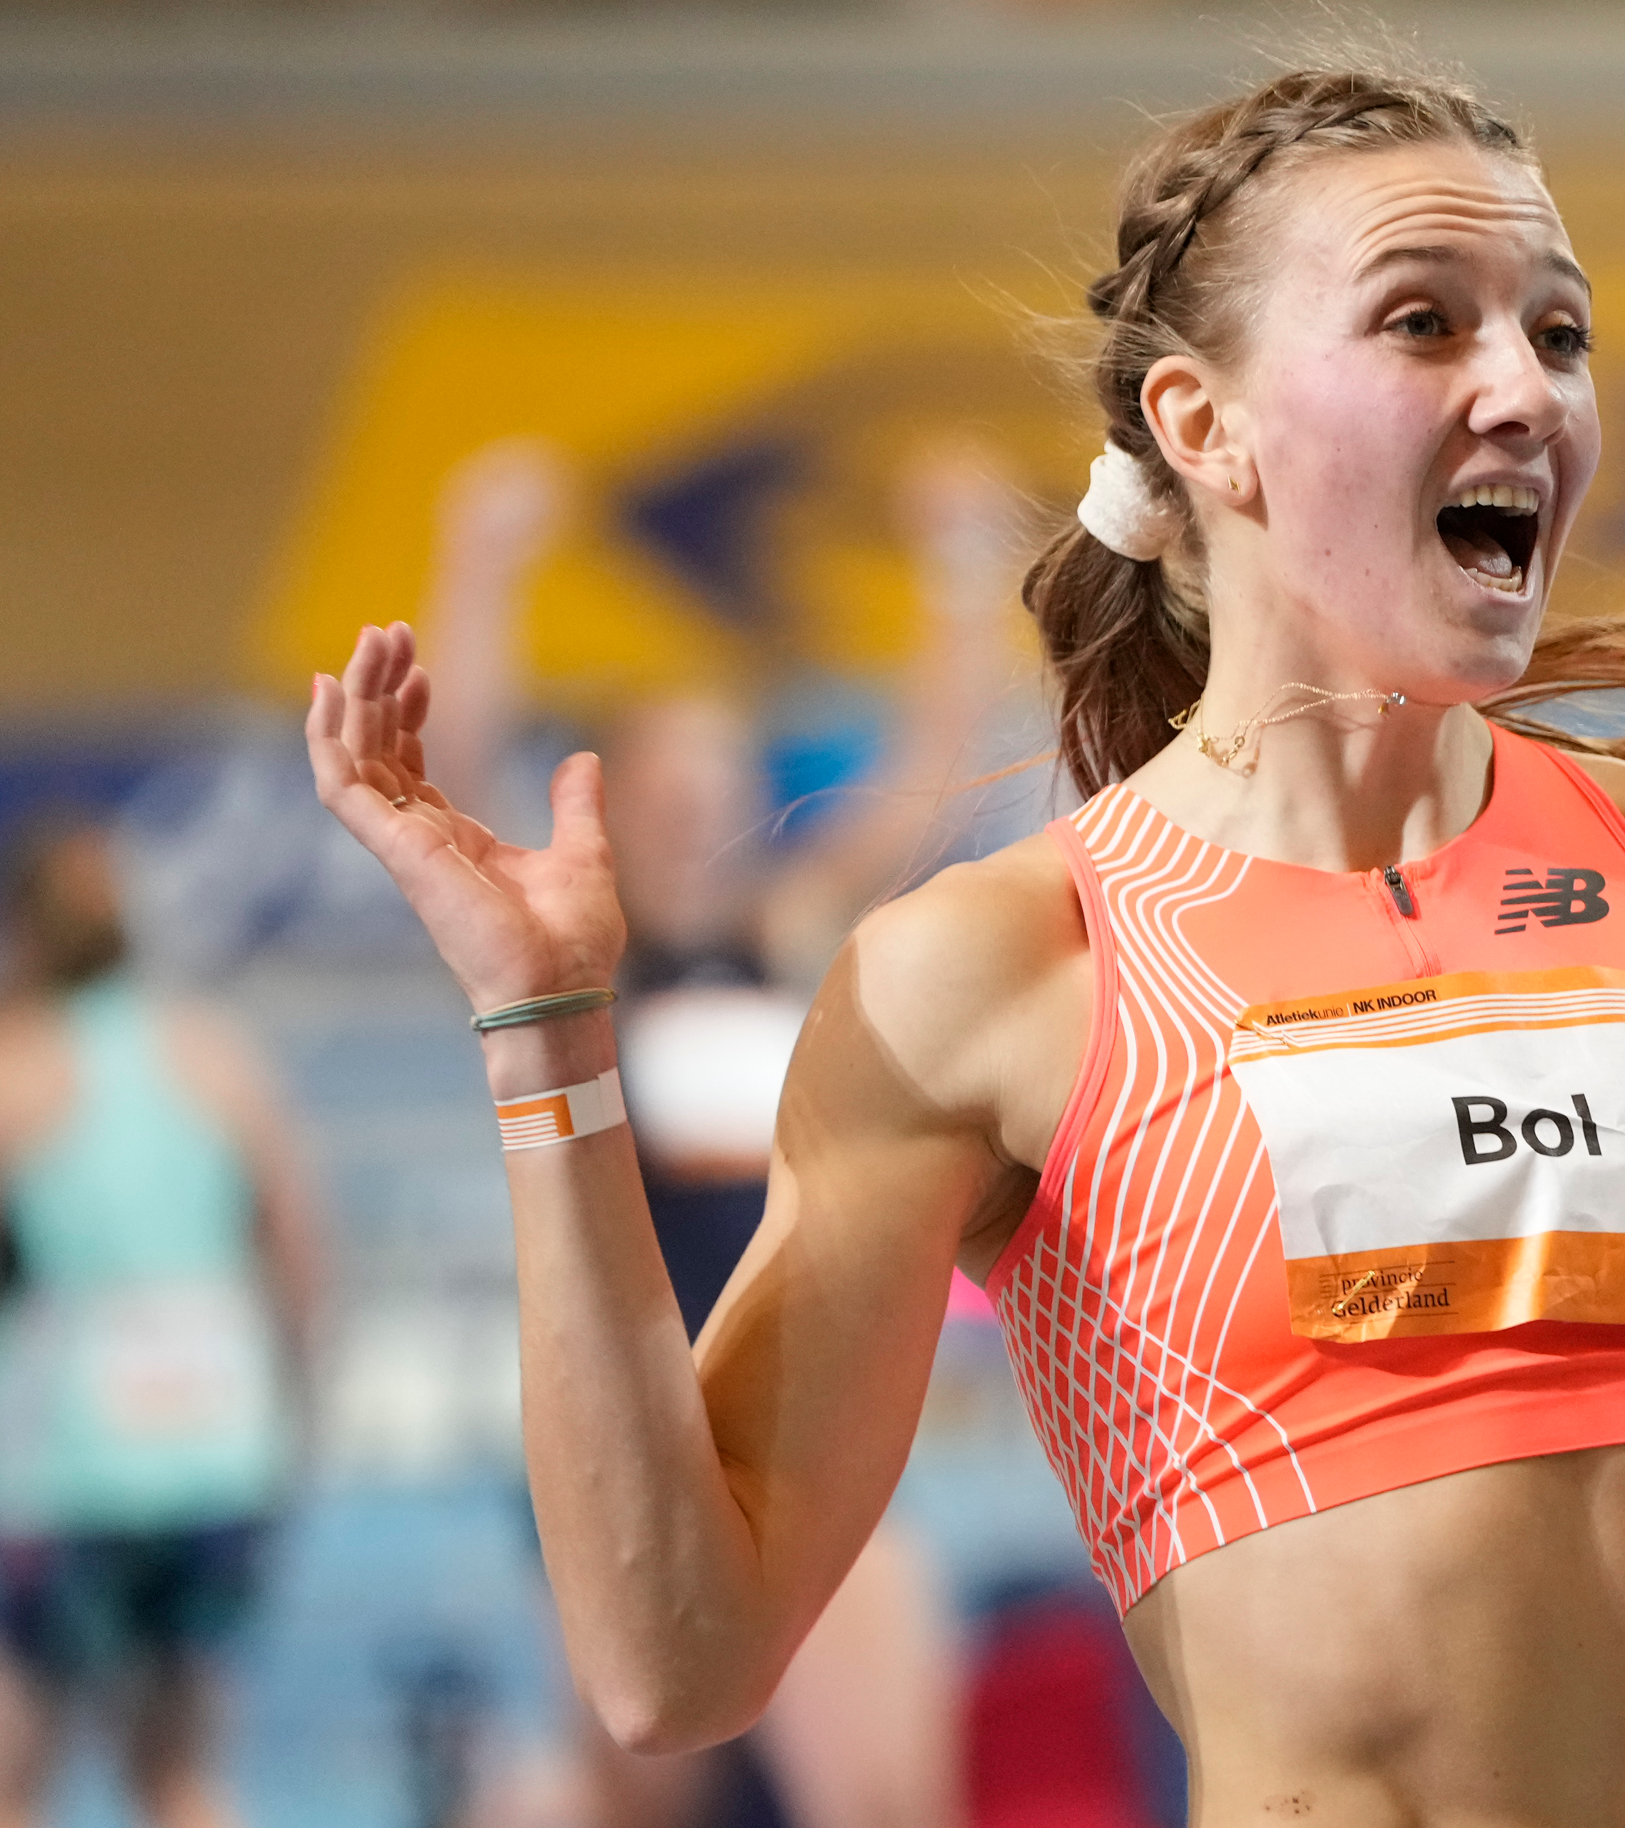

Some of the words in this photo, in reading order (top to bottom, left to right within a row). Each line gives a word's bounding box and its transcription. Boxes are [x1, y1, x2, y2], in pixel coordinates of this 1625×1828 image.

[1266, 1005, 1344, 1026] Atletiekunie
[1353, 1000, 1375, 1014] NK
[1377, 989, 1437, 1010] INDOOR
[1451, 1093, 1602, 1166] Bol
[1331, 1287, 1450, 1318] Gelderland
